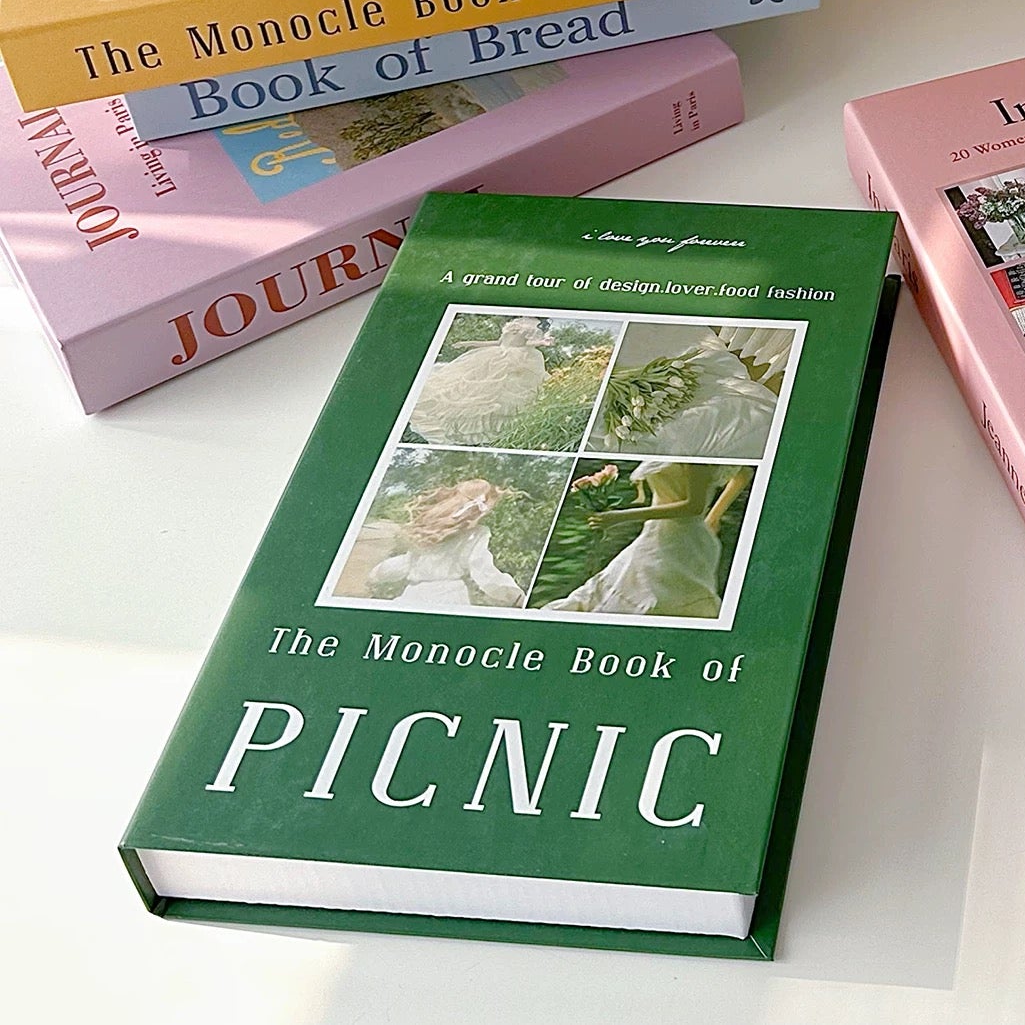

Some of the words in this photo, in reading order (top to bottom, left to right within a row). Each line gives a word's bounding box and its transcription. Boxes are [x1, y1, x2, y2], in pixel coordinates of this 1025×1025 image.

[74, 40, 163, 81] The
[179, 58, 346, 121] Book
[374, 37, 434, 82] of
[463, 0, 636, 65] Bread
[104, 96, 134, 137] Paris
[671, 100, 684, 135] Living
[686, 90, 699, 119] Paris
[691, 119, 701, 132] in
[139, 147, 178, 198] Living
[949, 149, 971, 164] 20
[439, 270, 454, 284] A
[461, 272, 521, 287] grand
[525, 274, 567, 289] tour
[573, 275, 594, 290] of
[766, 285, 837, 303] fashion
[267, 626, 341, 659] The
[361, 631, 546, 673] Monocle
[569, 646, 677, 680] Book
[701, 654, 746, 684] of
[204, 699, 723, 828] PICNIC
